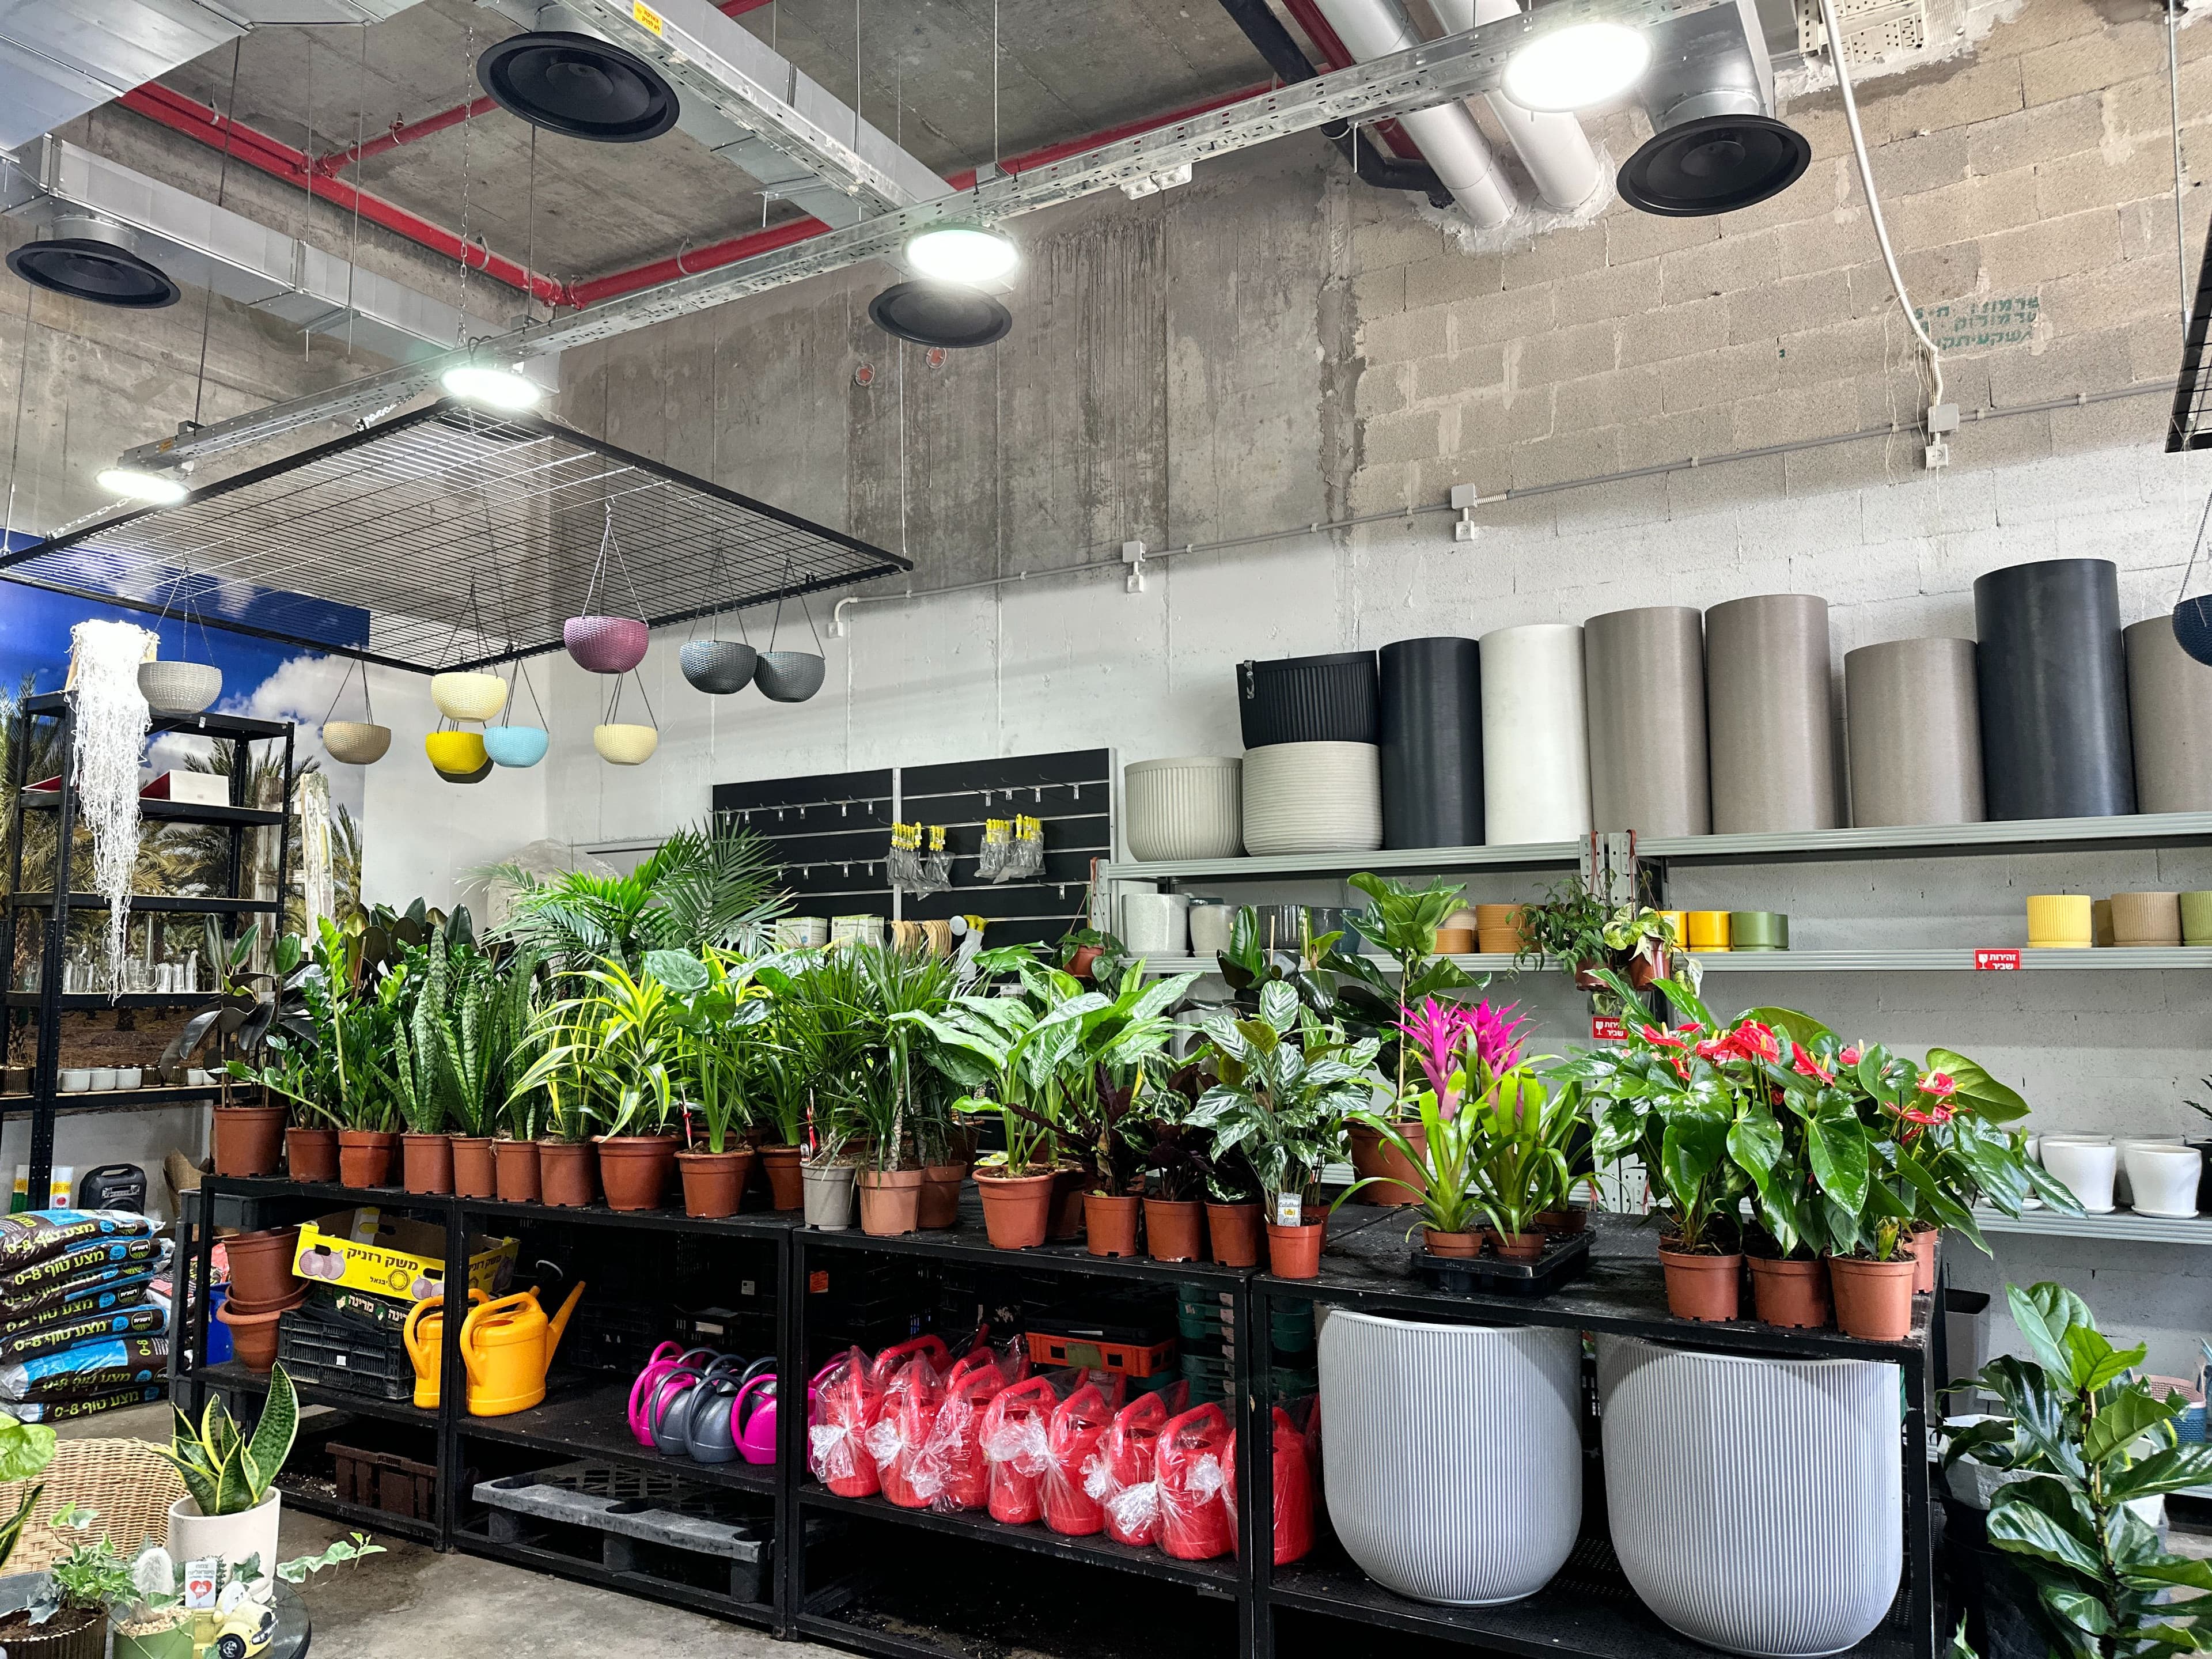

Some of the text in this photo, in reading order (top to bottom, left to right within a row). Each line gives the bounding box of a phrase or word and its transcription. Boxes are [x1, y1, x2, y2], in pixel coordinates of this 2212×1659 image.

[74, 1249, 104, 1266] מצע
[347, 1248, 419, 1271] משק רזניק
[44, 1260, 70, 1278] טוף
[14, 1269, 42, 1286] 0-8
[369, 1276, 388, 1285] יבנאל
[120, 1287, 138, 1297] דשנית
[62, 1299, 93, 1315] מצע
[348, 1294, 374, 1313] מרינה
[133, 1316, 150, 1324] דשנית
[13, 1320, 107, 1351] מצע טוף 0-8
[100, 1371, 131, 1383] מצע
[82, 1399, 107, 1414] טוף
[111, 1391, 139, 1407] מצע
[54, 1403, 79, 1418] 0-8
